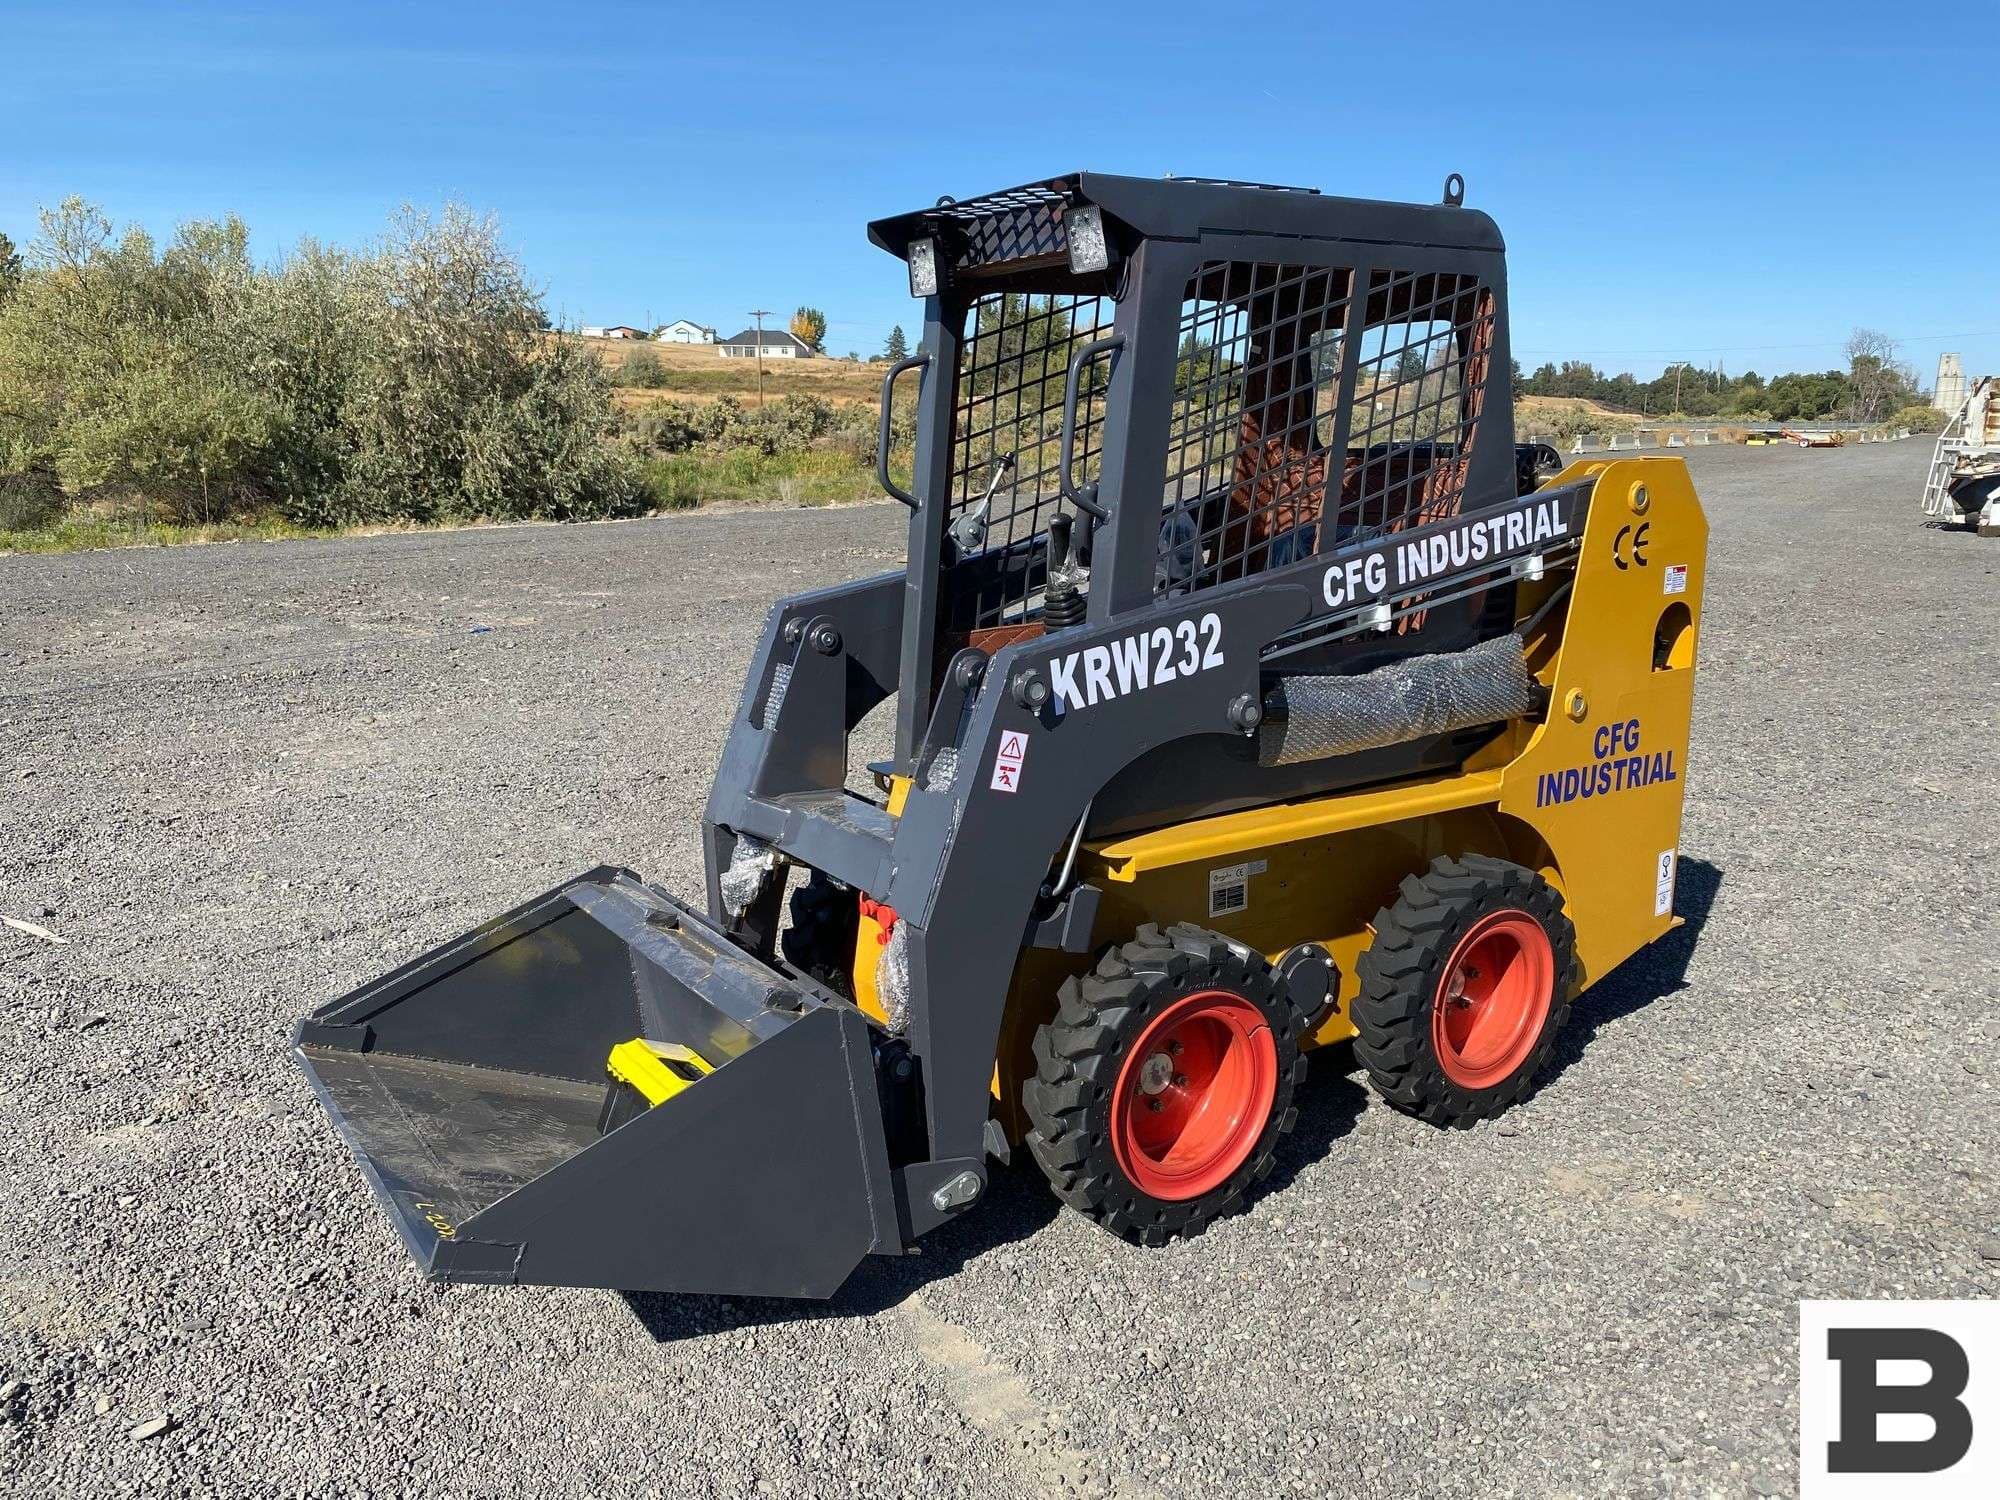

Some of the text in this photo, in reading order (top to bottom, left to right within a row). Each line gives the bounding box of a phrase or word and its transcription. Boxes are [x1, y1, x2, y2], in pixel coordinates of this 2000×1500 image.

[1323, 499, 1569, 607] CFG INDUSTRIAL
[1613, 521, 1650, 571] CE
[1050, 612, 1225, 716] KRW232
[1593, 719, 1640, 760] CFG
[1536, 750, 1677, 808] INDUSTRIAL
